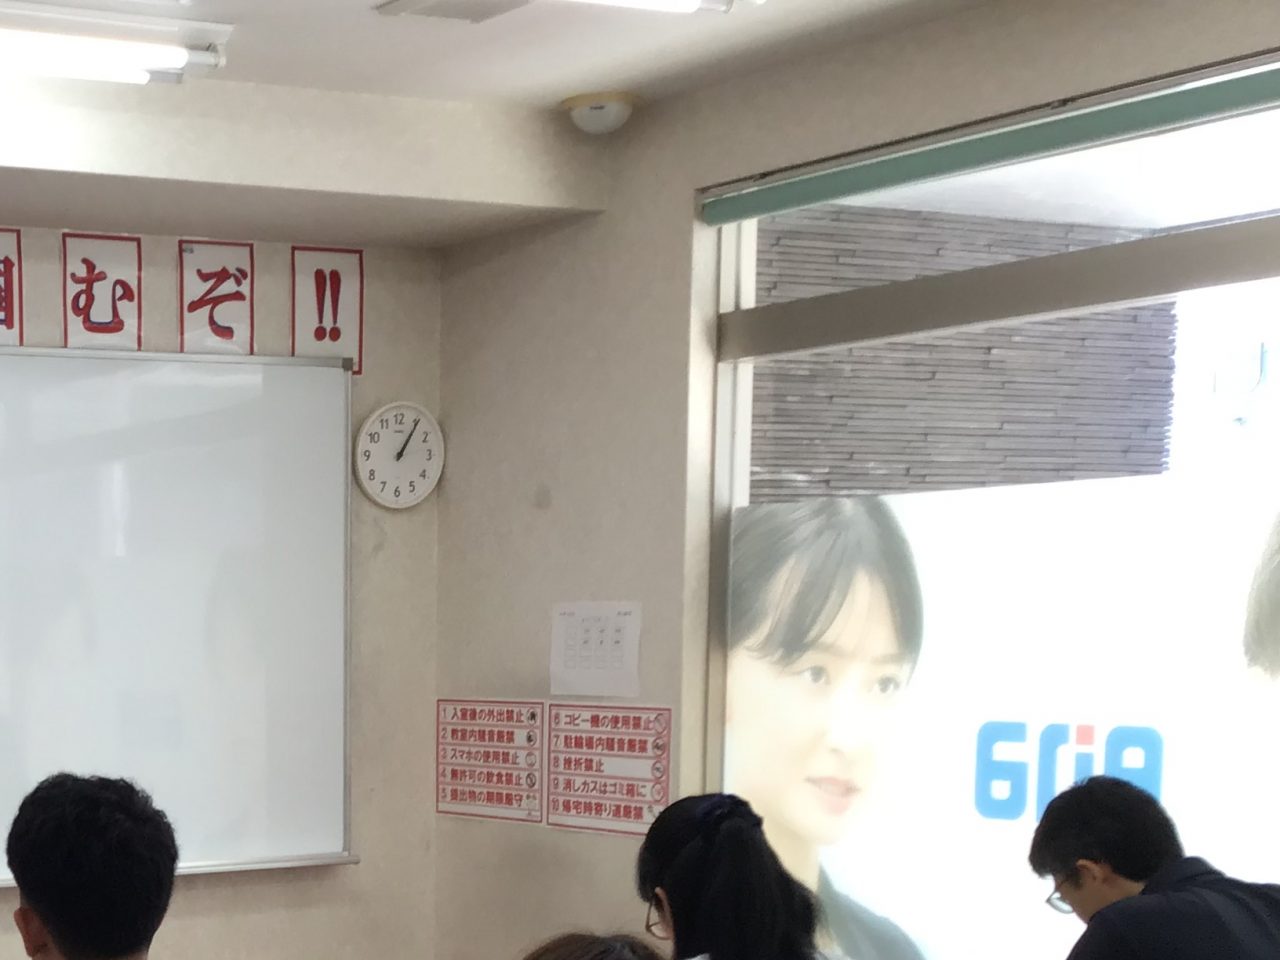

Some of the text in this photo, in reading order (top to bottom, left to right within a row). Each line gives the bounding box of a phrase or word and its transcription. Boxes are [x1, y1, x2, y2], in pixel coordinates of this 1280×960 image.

[379, 418, 389, 430] 11
[393, 413, 405, 425] 12
[368, 432, 380, 444] 10
[422, 431, 429, 444] 2
[363, 449, 371, 461] 9
[425, 449, 432, 461] 3
[368, 469, 376, 481] 8
[419, 469, 426, 480] 4
[380, 481, 387, 493] 7
[394, 486, 401, 498] 6
[409, 481, 416, 493] 5
